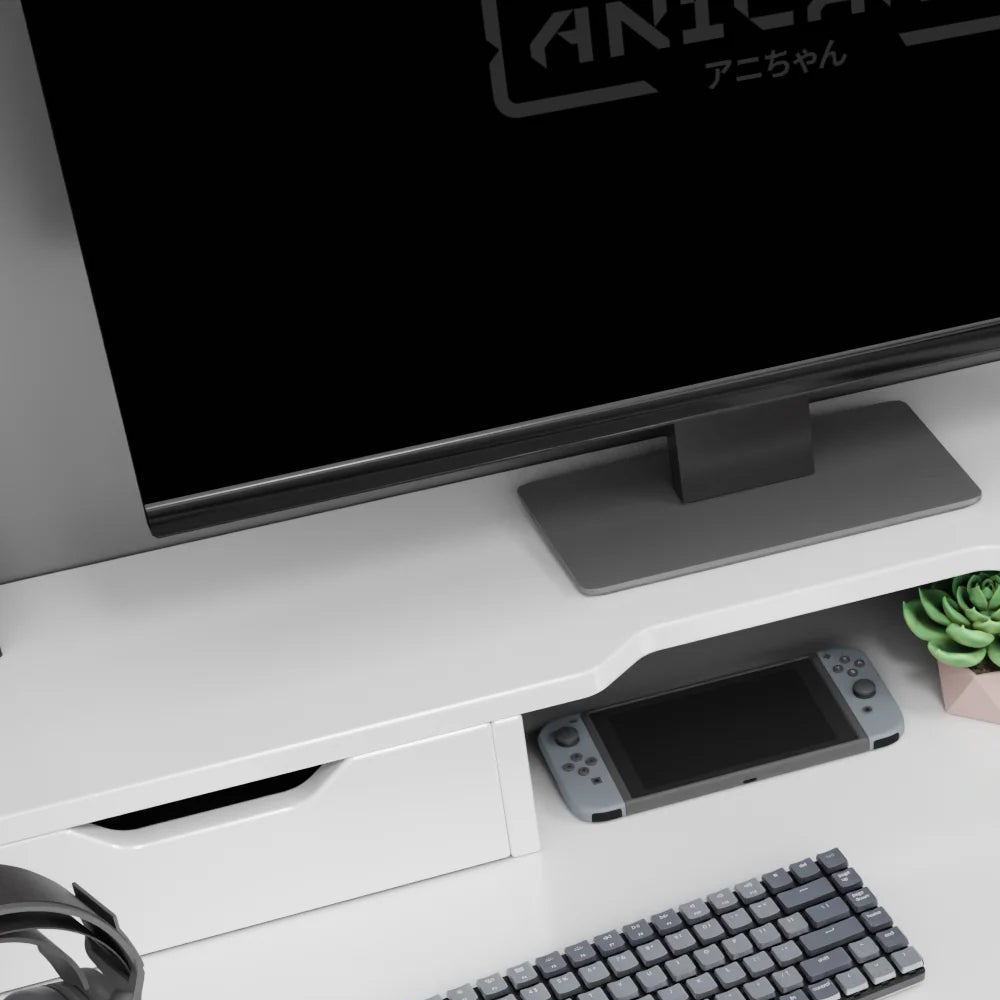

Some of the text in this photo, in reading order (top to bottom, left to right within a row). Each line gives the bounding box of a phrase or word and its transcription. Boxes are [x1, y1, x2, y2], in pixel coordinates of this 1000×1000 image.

[704, 40, 848, 90] アニちゃん
